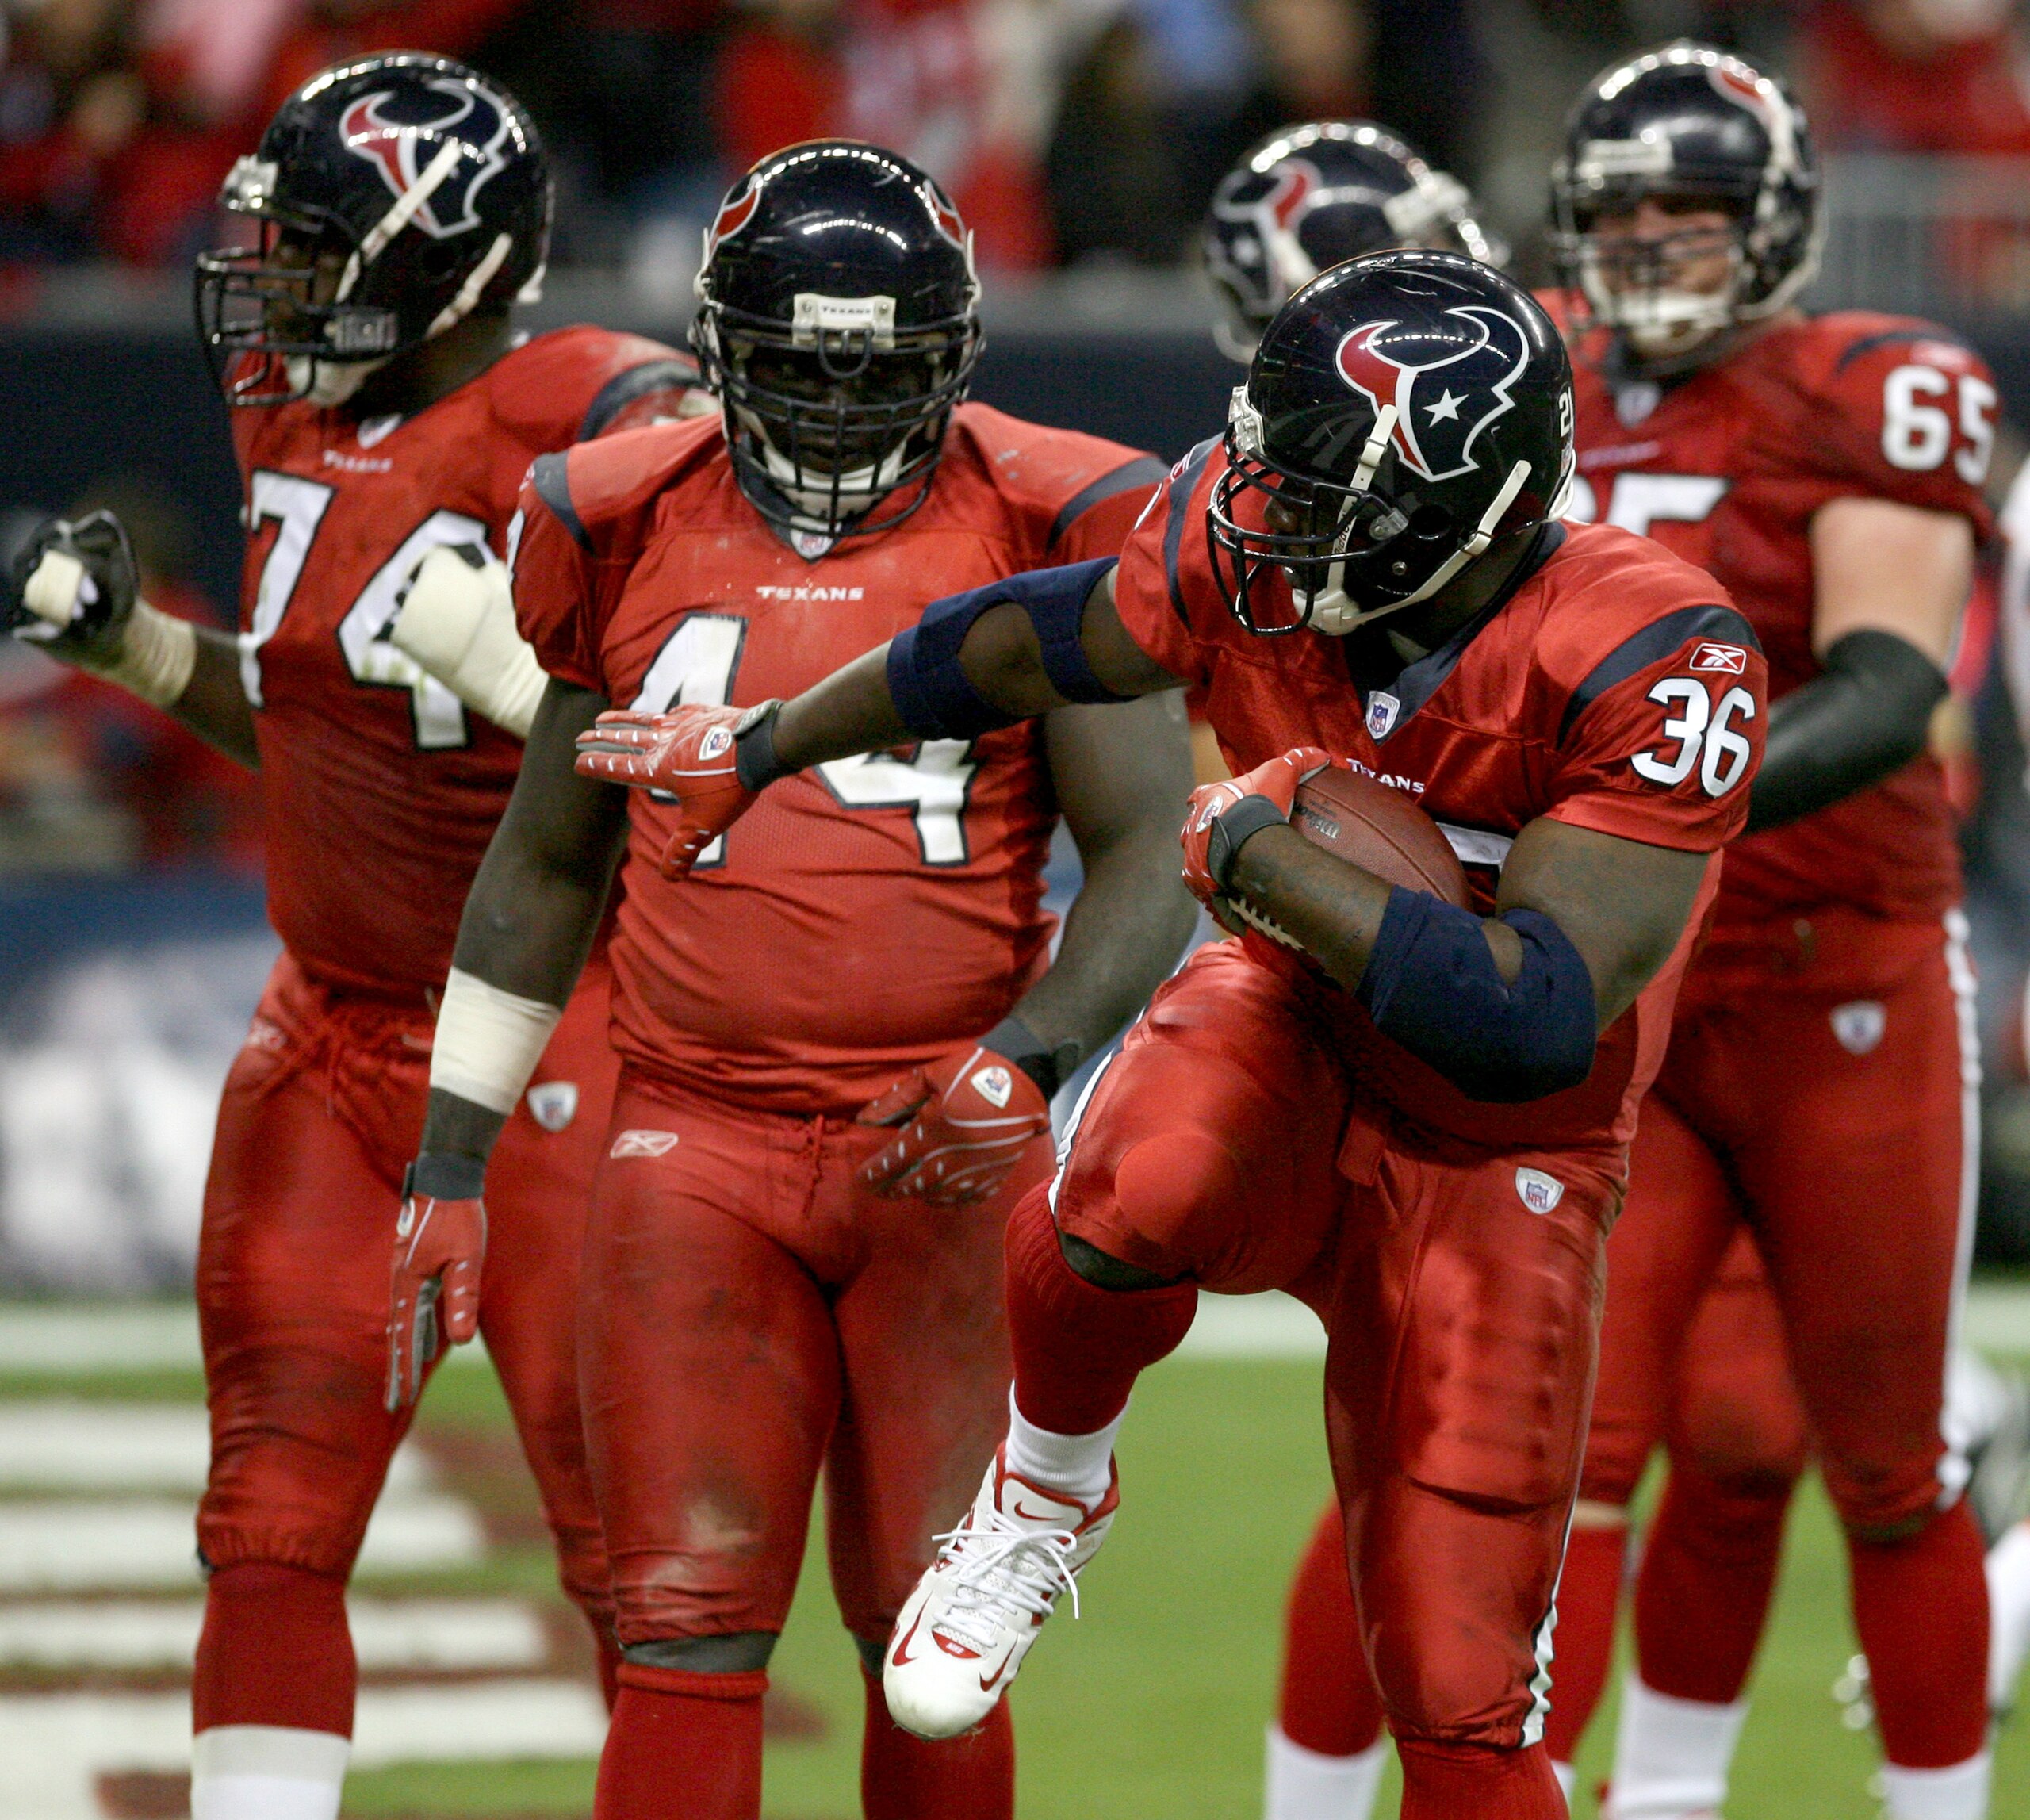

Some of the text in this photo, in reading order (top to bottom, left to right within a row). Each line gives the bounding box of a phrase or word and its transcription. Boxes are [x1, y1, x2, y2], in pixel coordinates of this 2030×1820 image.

[1881, 364, 1999, 486] 65
[239, 468, 493, 749] 74
[756, 585, 864, 601] TEXANS
[1630, 677, 1756, 799] 36
